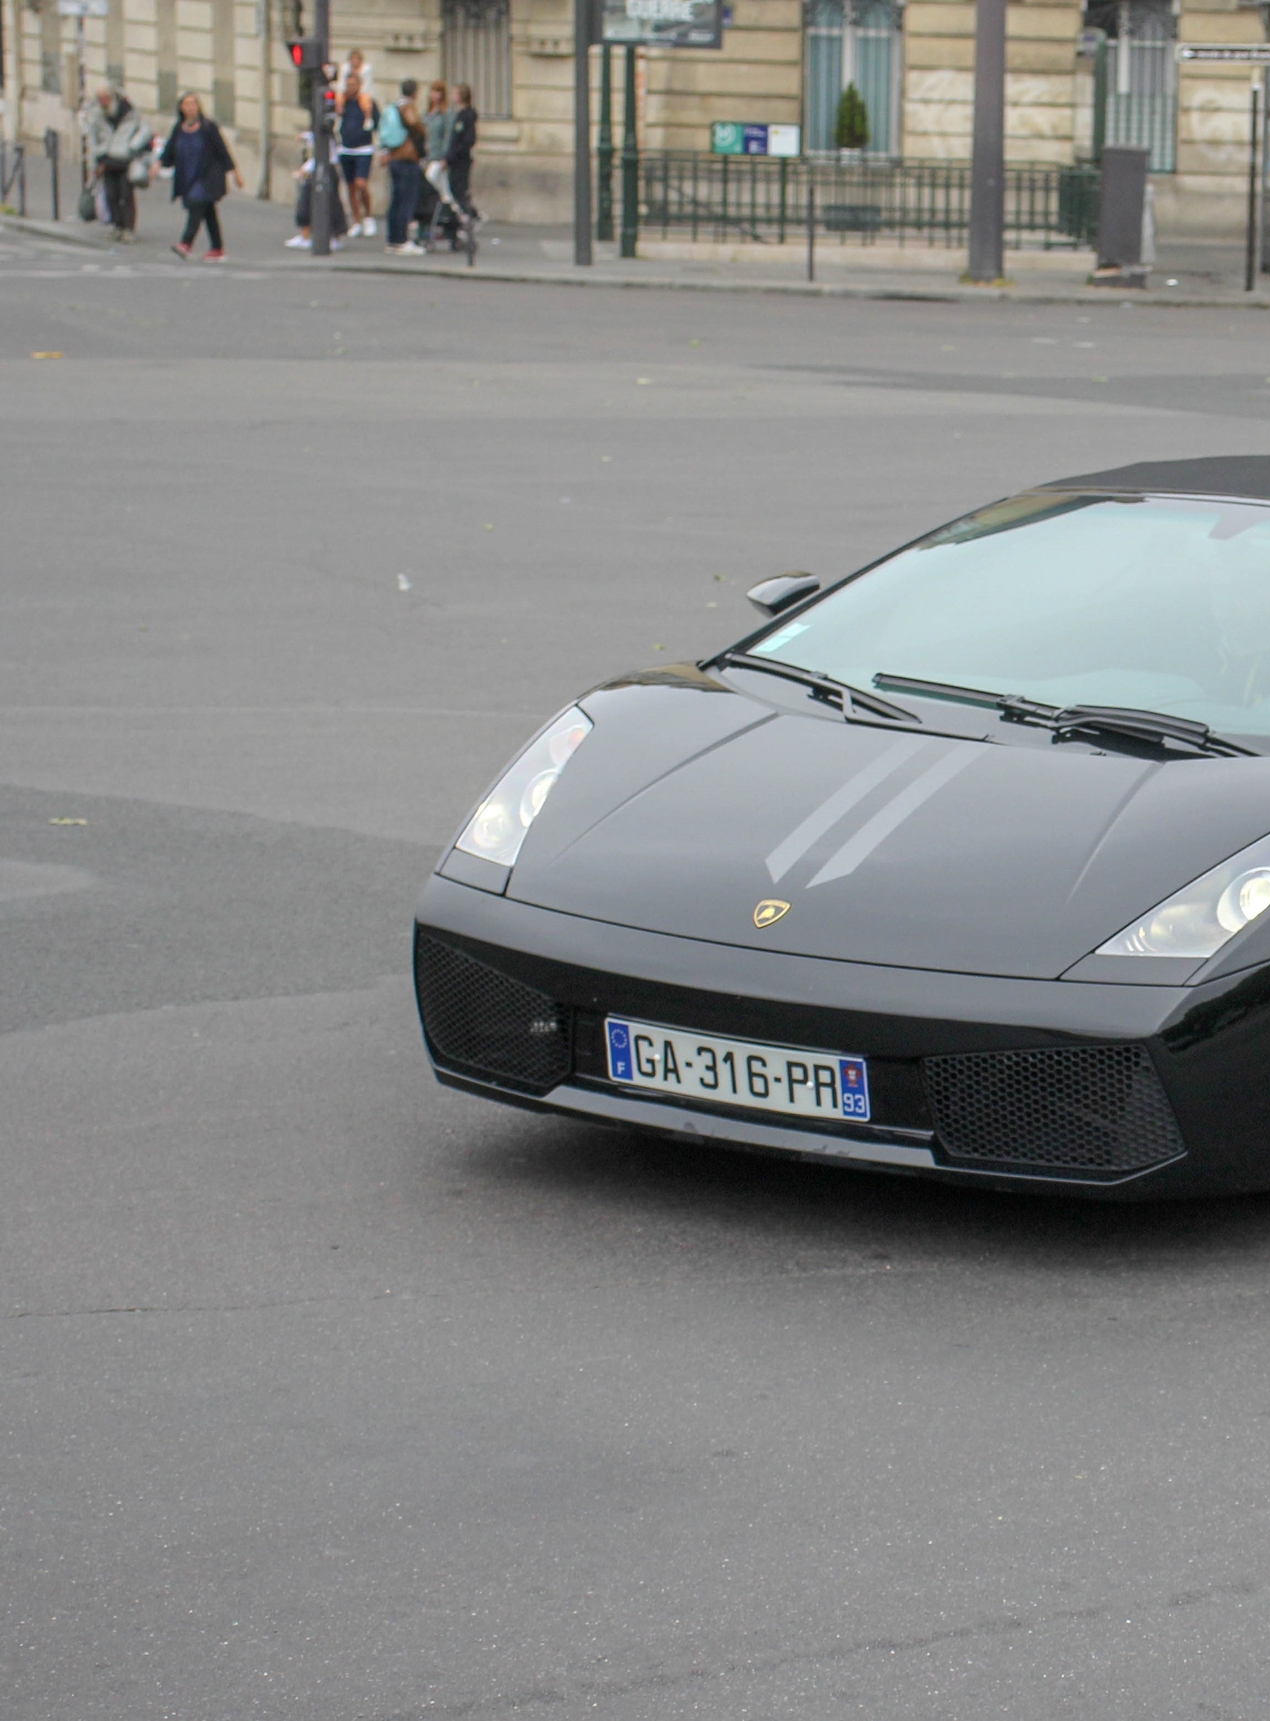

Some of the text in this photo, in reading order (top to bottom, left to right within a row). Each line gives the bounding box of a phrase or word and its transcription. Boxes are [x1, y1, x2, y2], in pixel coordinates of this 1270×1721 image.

[616, 1061, 626, 1075] F
[634, 1034, 838, 1109] GA-316-PR
[842, 1092, 866, 1114] 93
